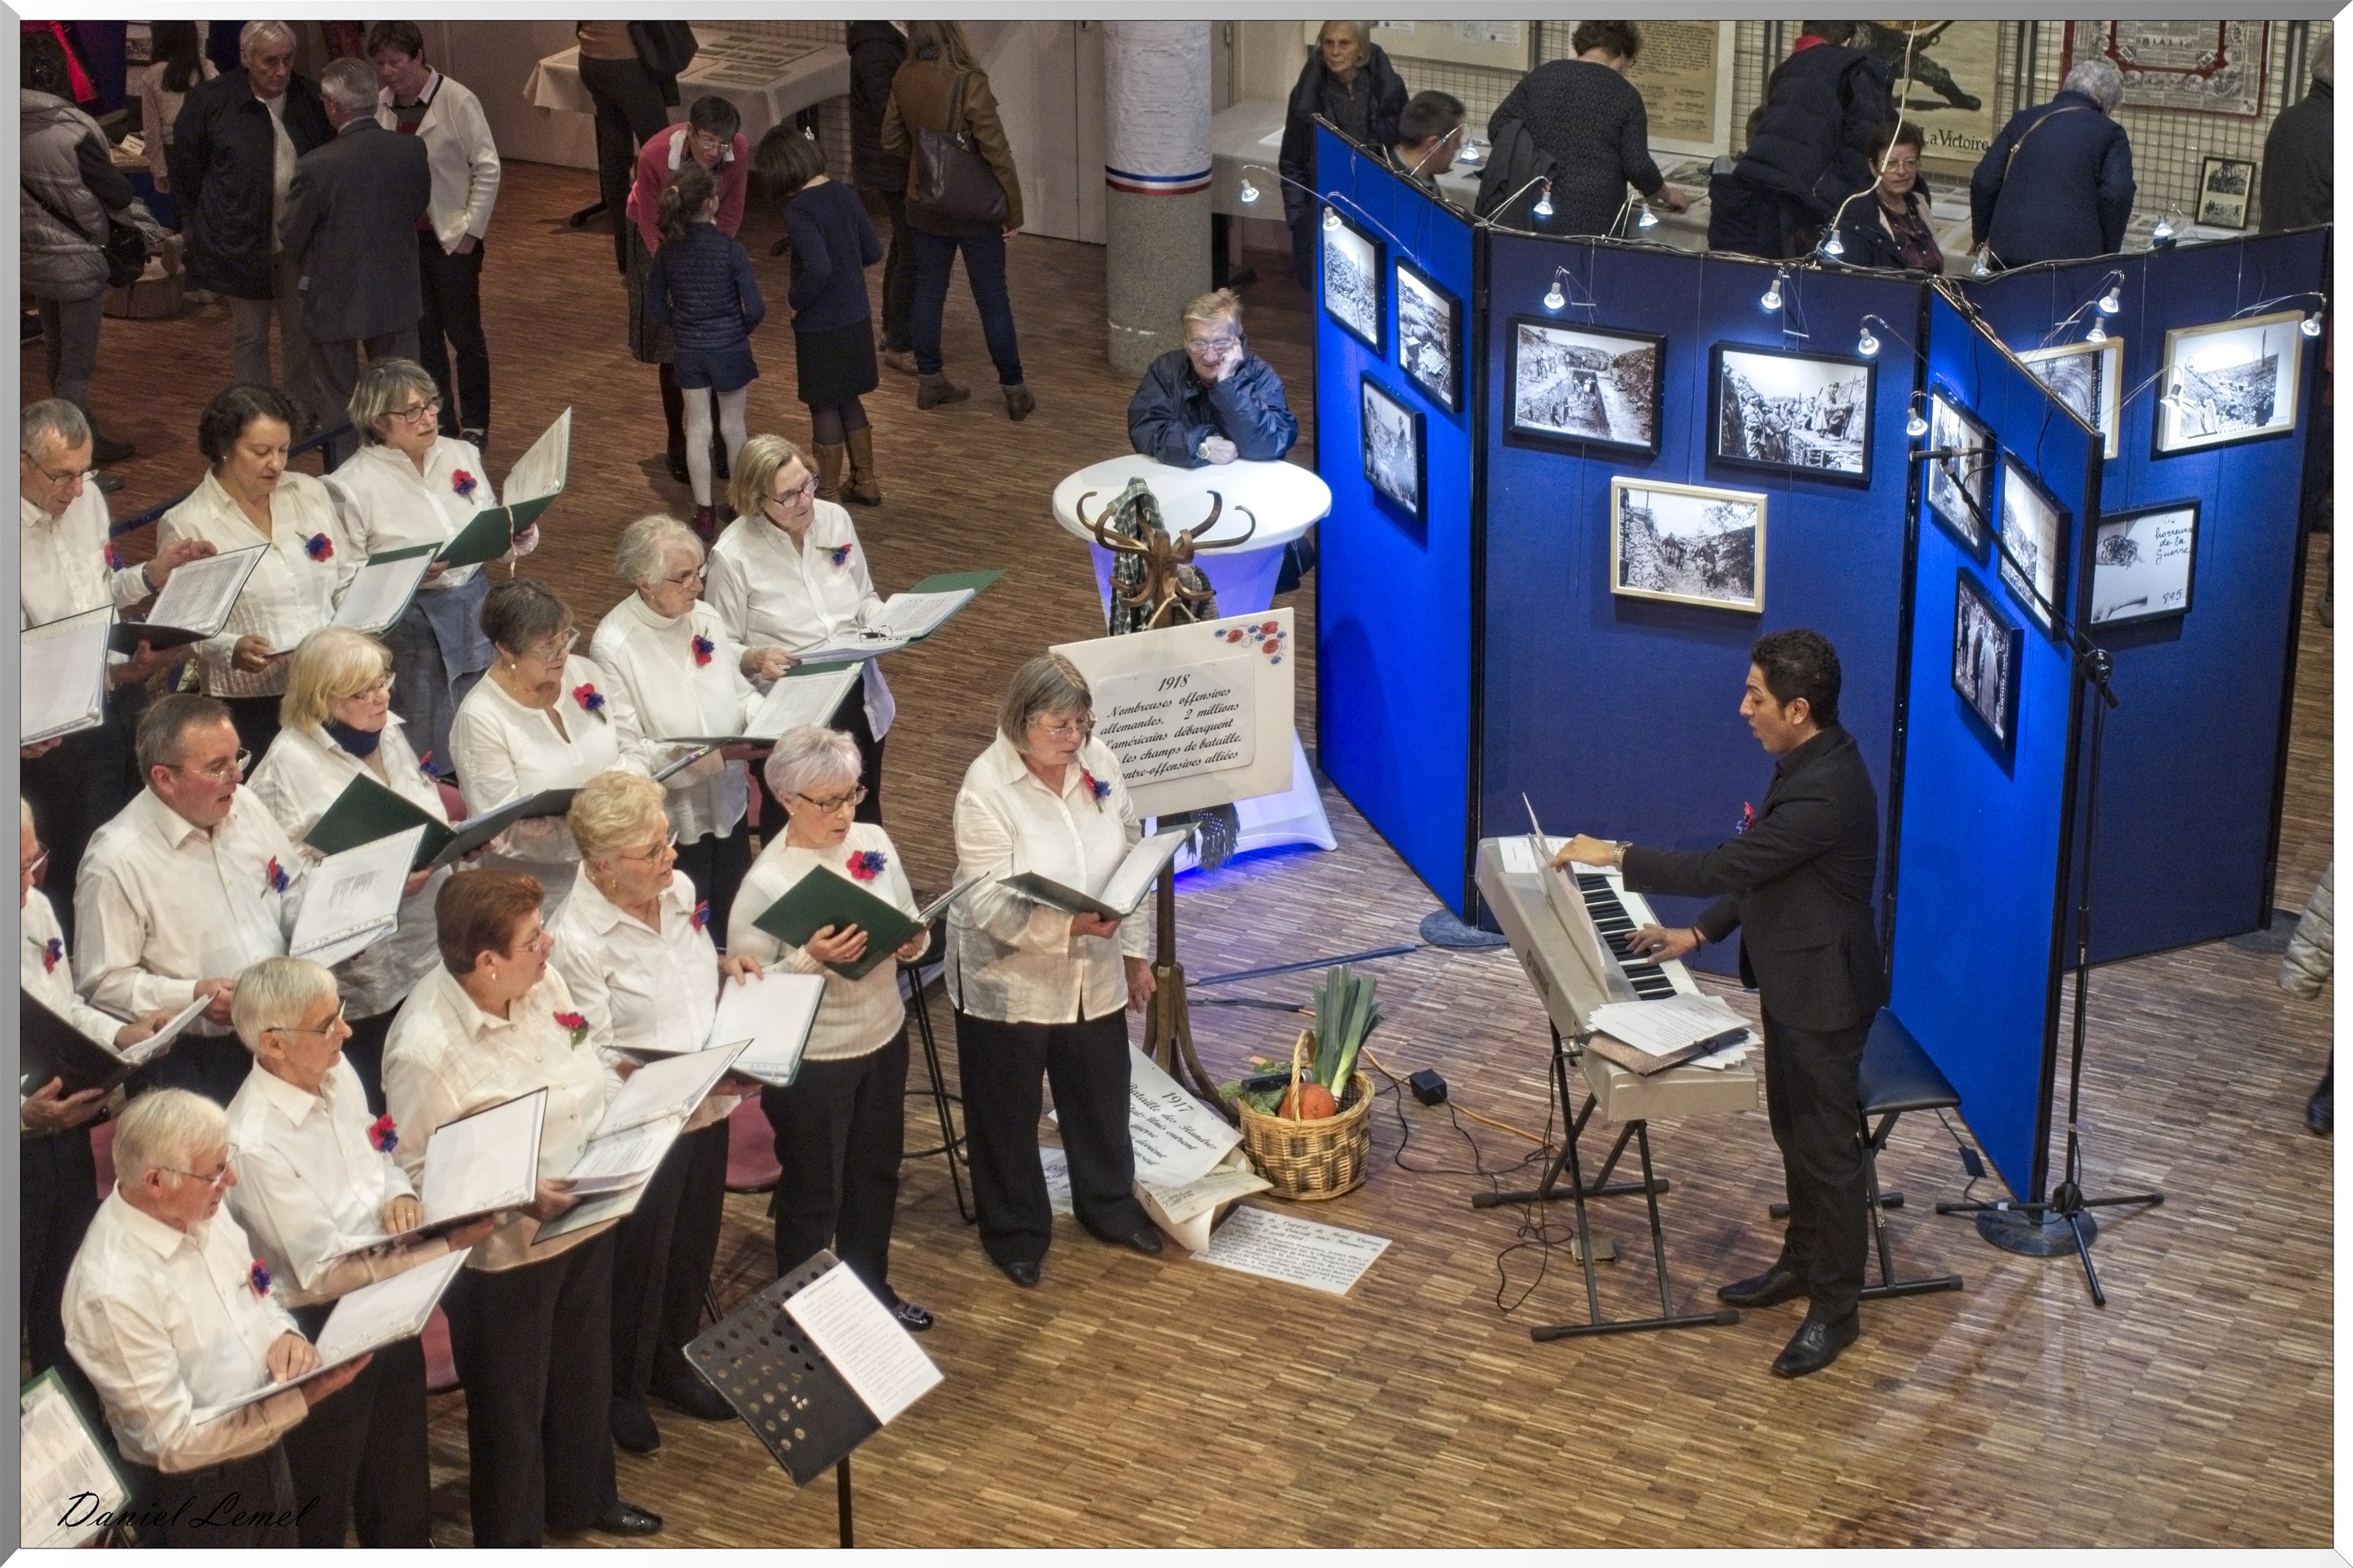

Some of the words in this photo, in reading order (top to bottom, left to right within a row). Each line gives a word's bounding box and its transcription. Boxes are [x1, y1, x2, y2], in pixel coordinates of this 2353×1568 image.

[1938, 128, 1989, 151] Victoire
[2159, 538, 2172, 547] de
[1158, 673, 1191, 692] 1918
[1107, 700, 1172, 718] Nombreuses
[1179, 688, 1230, 707] offensives
[1100, 716, 1164, 735] allemandes.
[1184, 708, 1193, 720] 2
[1197, 703, 1239, 717] millions
[1174, 718, 1234, 738] débarquent
[1122, 753, 1136, 764] les
[1140, 747, 1181, 759] champs
[1184, 741, 1197, 753] de
[1199, 732, 1241, 749] bataille.
[1205, 750, 1239, 764] alliées
[1161, 1092, 1194, 1112] 1917
[1179, 1125, 1217, 1150] Flandres
